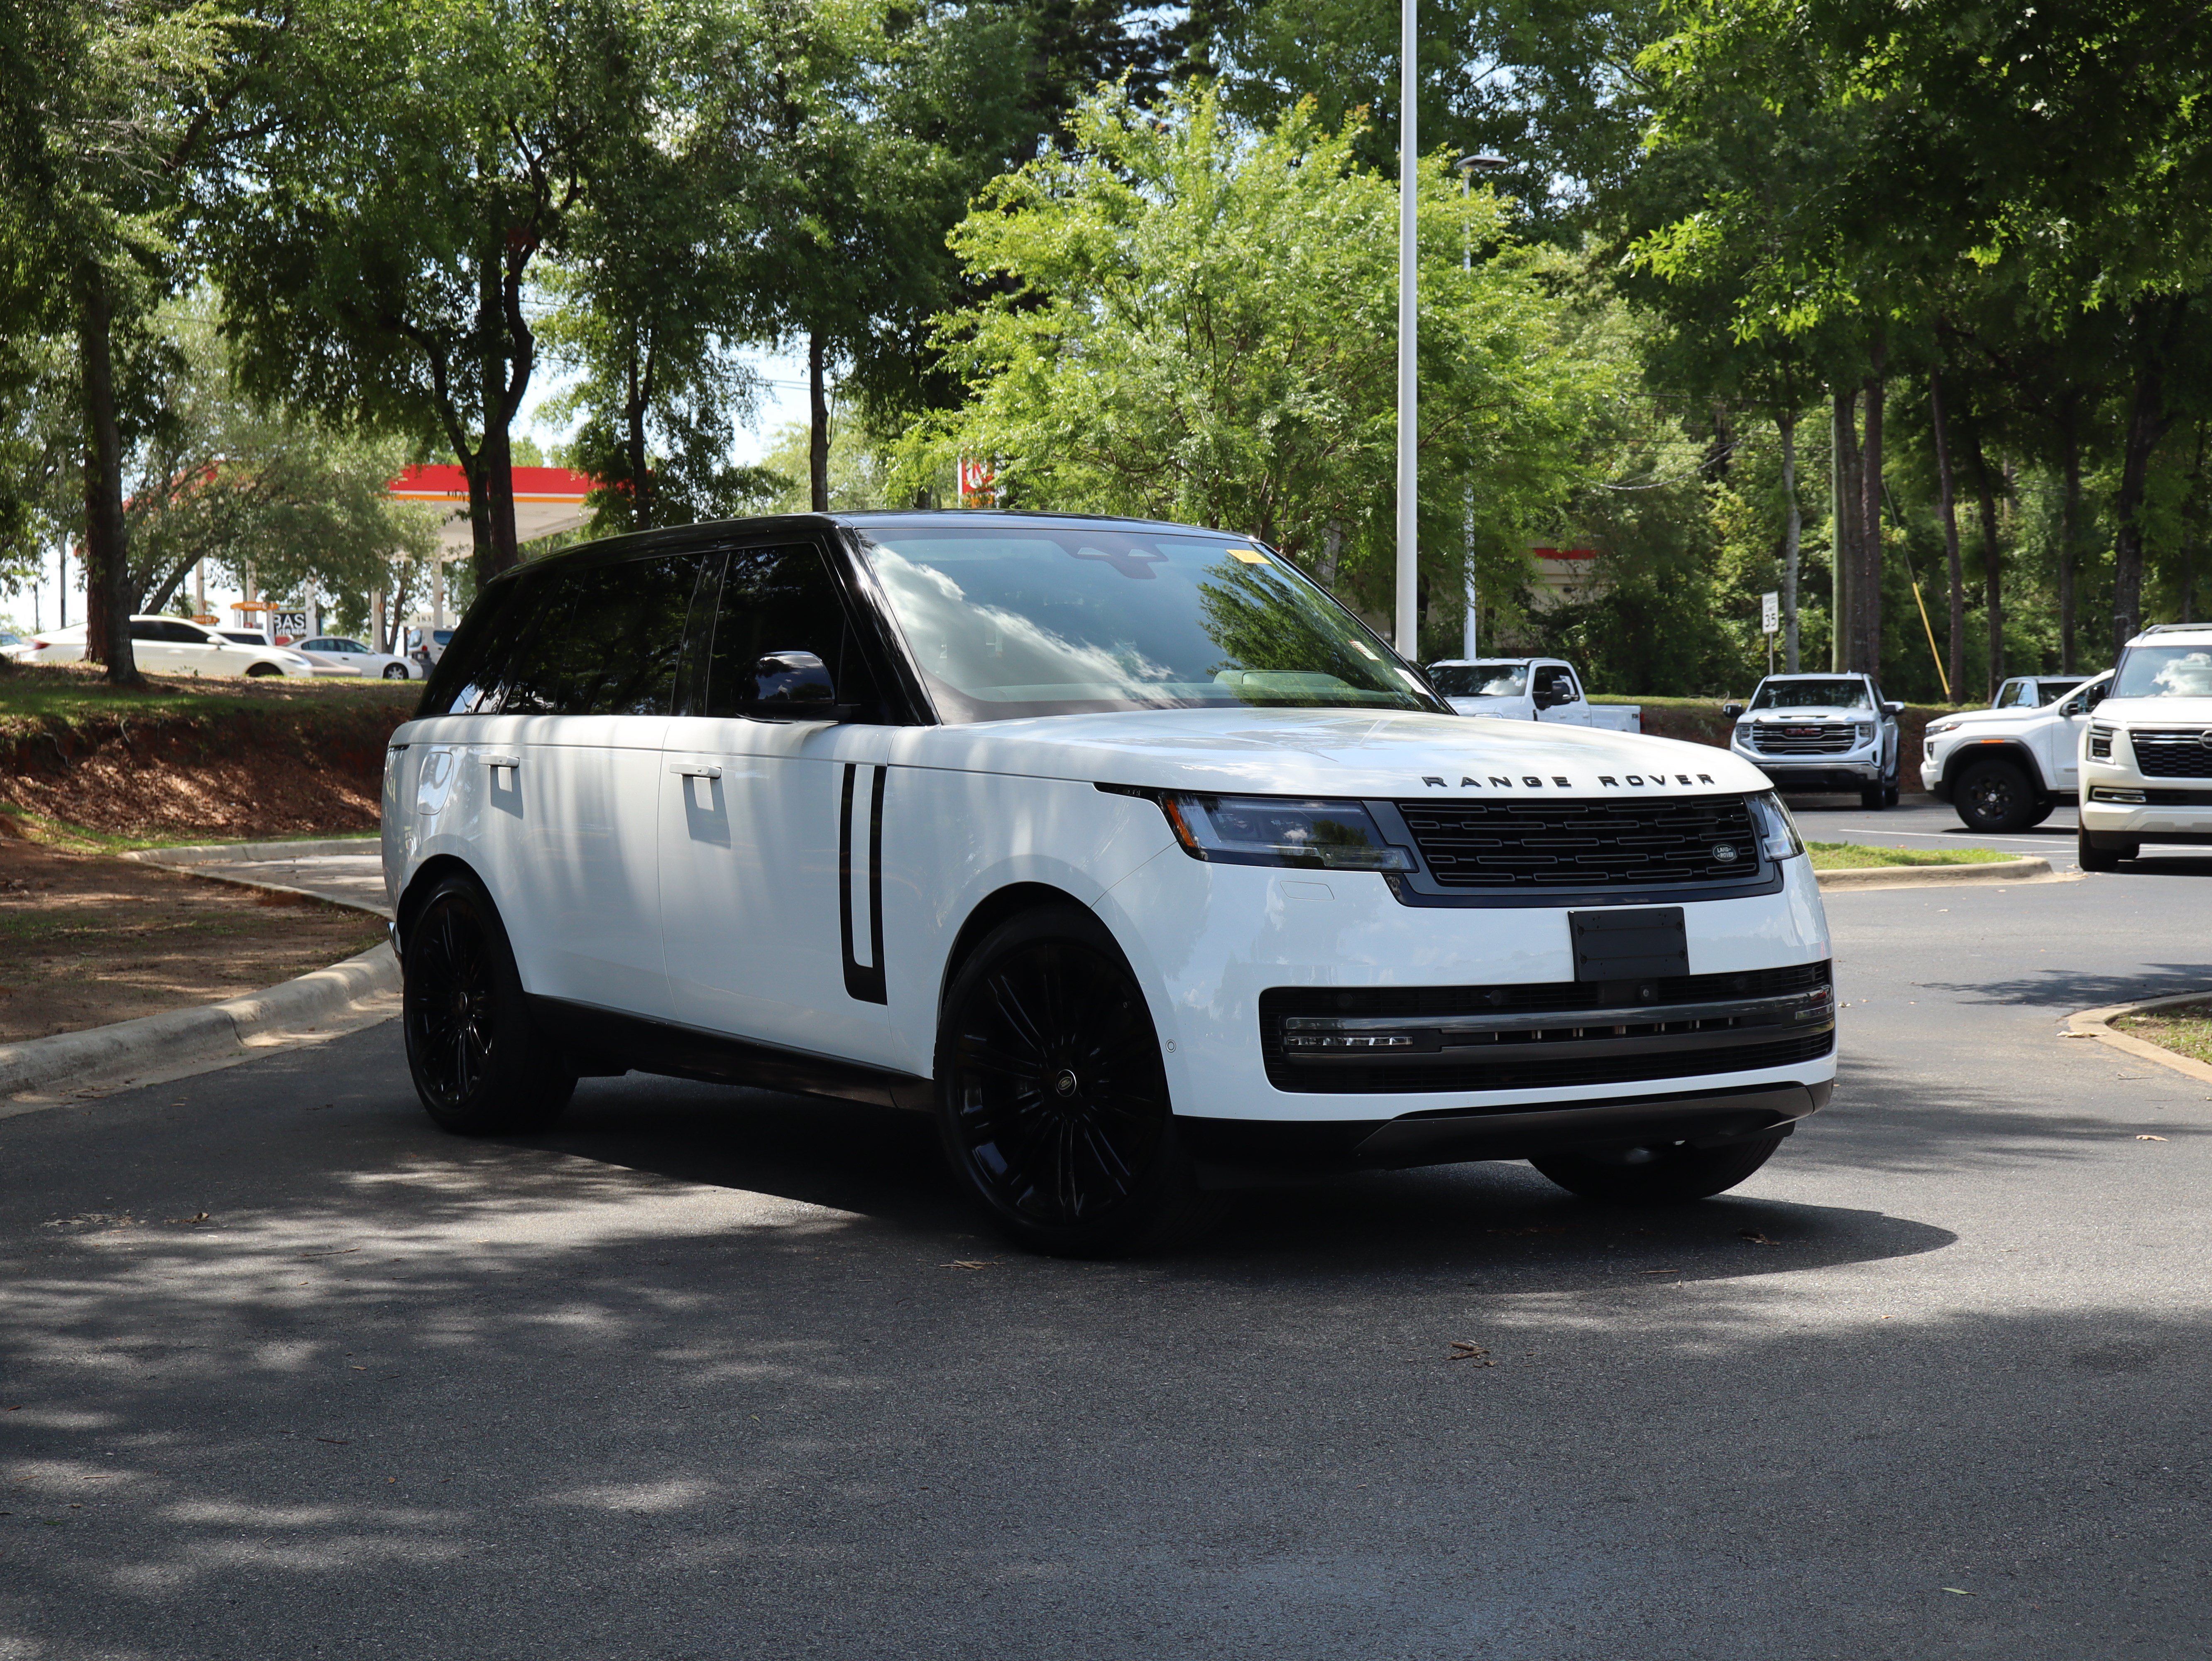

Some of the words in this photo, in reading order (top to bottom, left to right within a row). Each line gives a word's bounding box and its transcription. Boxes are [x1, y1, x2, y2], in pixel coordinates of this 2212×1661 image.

[1765, 613, 1777, 627] 35
[1422, 776, 1572, 787] RANGE
[1598, 774, 1715, 786] ROVER
